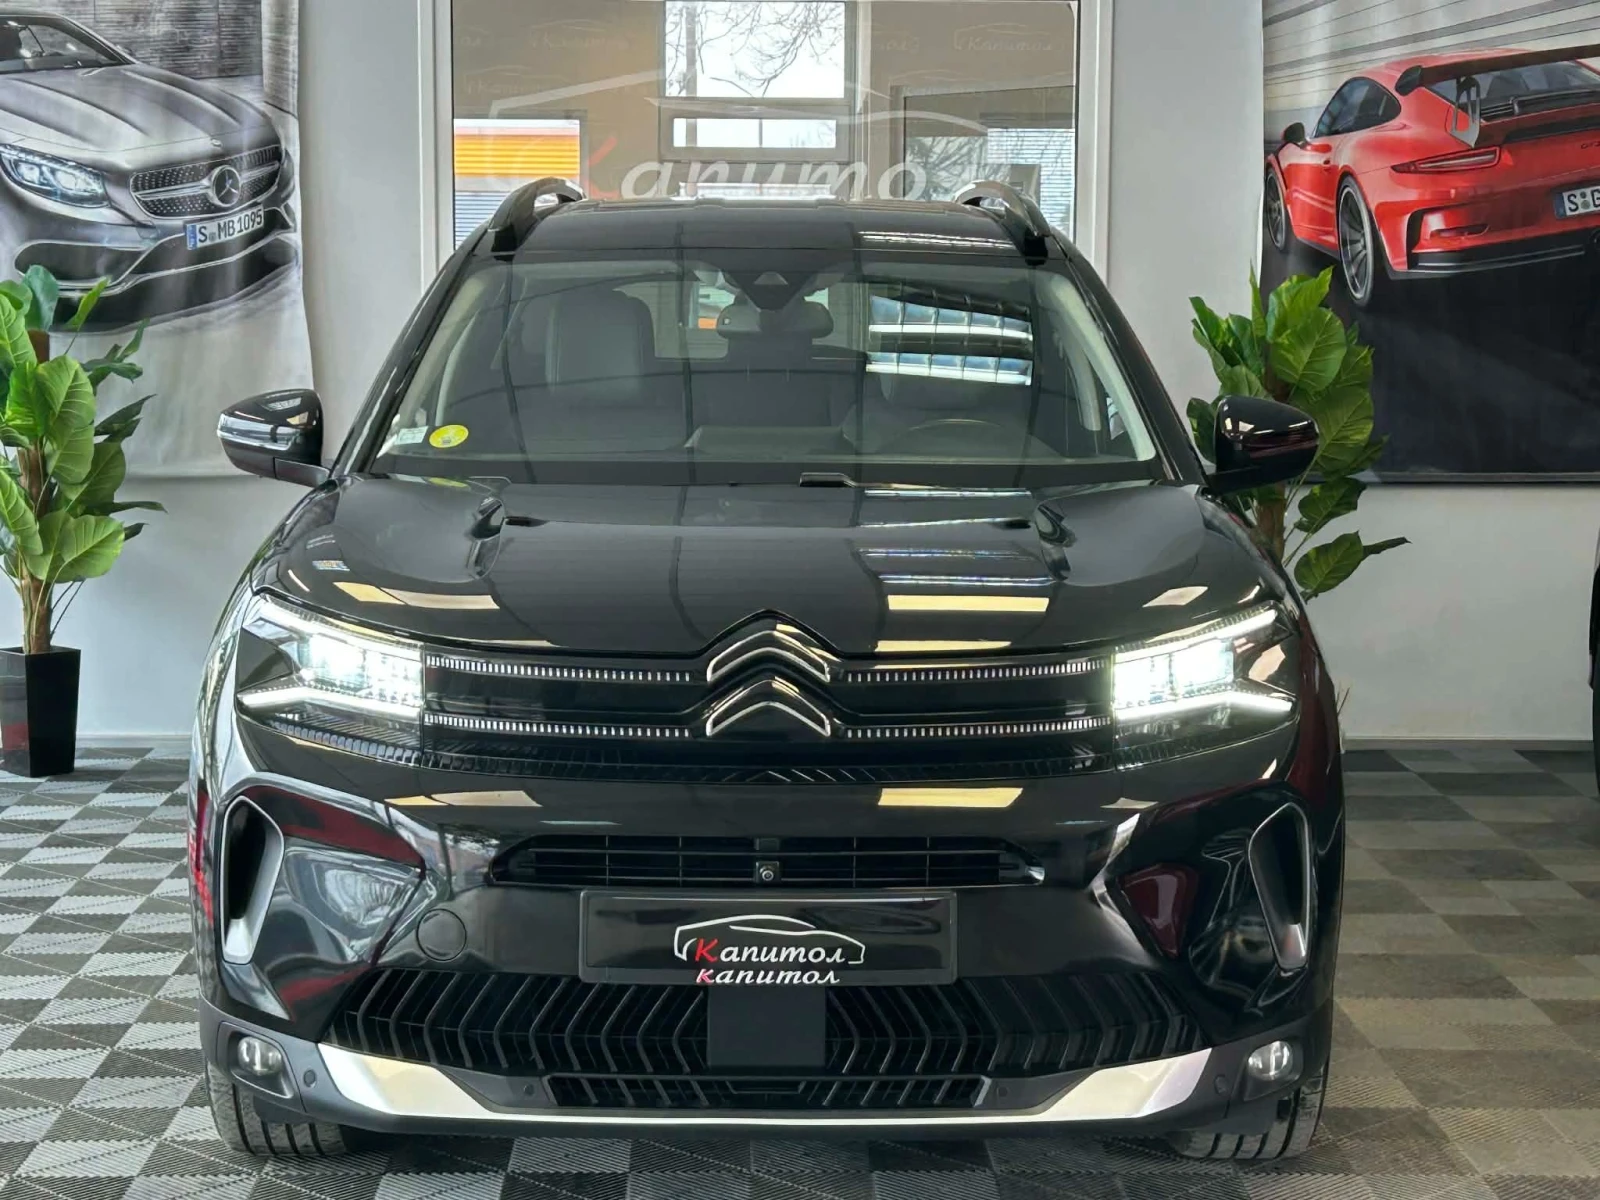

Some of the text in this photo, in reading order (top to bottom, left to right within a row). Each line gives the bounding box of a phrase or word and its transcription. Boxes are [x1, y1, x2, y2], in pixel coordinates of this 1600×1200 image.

[580, 136, 927, 201] Капито
[1567, 193, 1579, 212] S
[198, 226, 208, 243] S
[694, 938, 847, 963] Капитол
